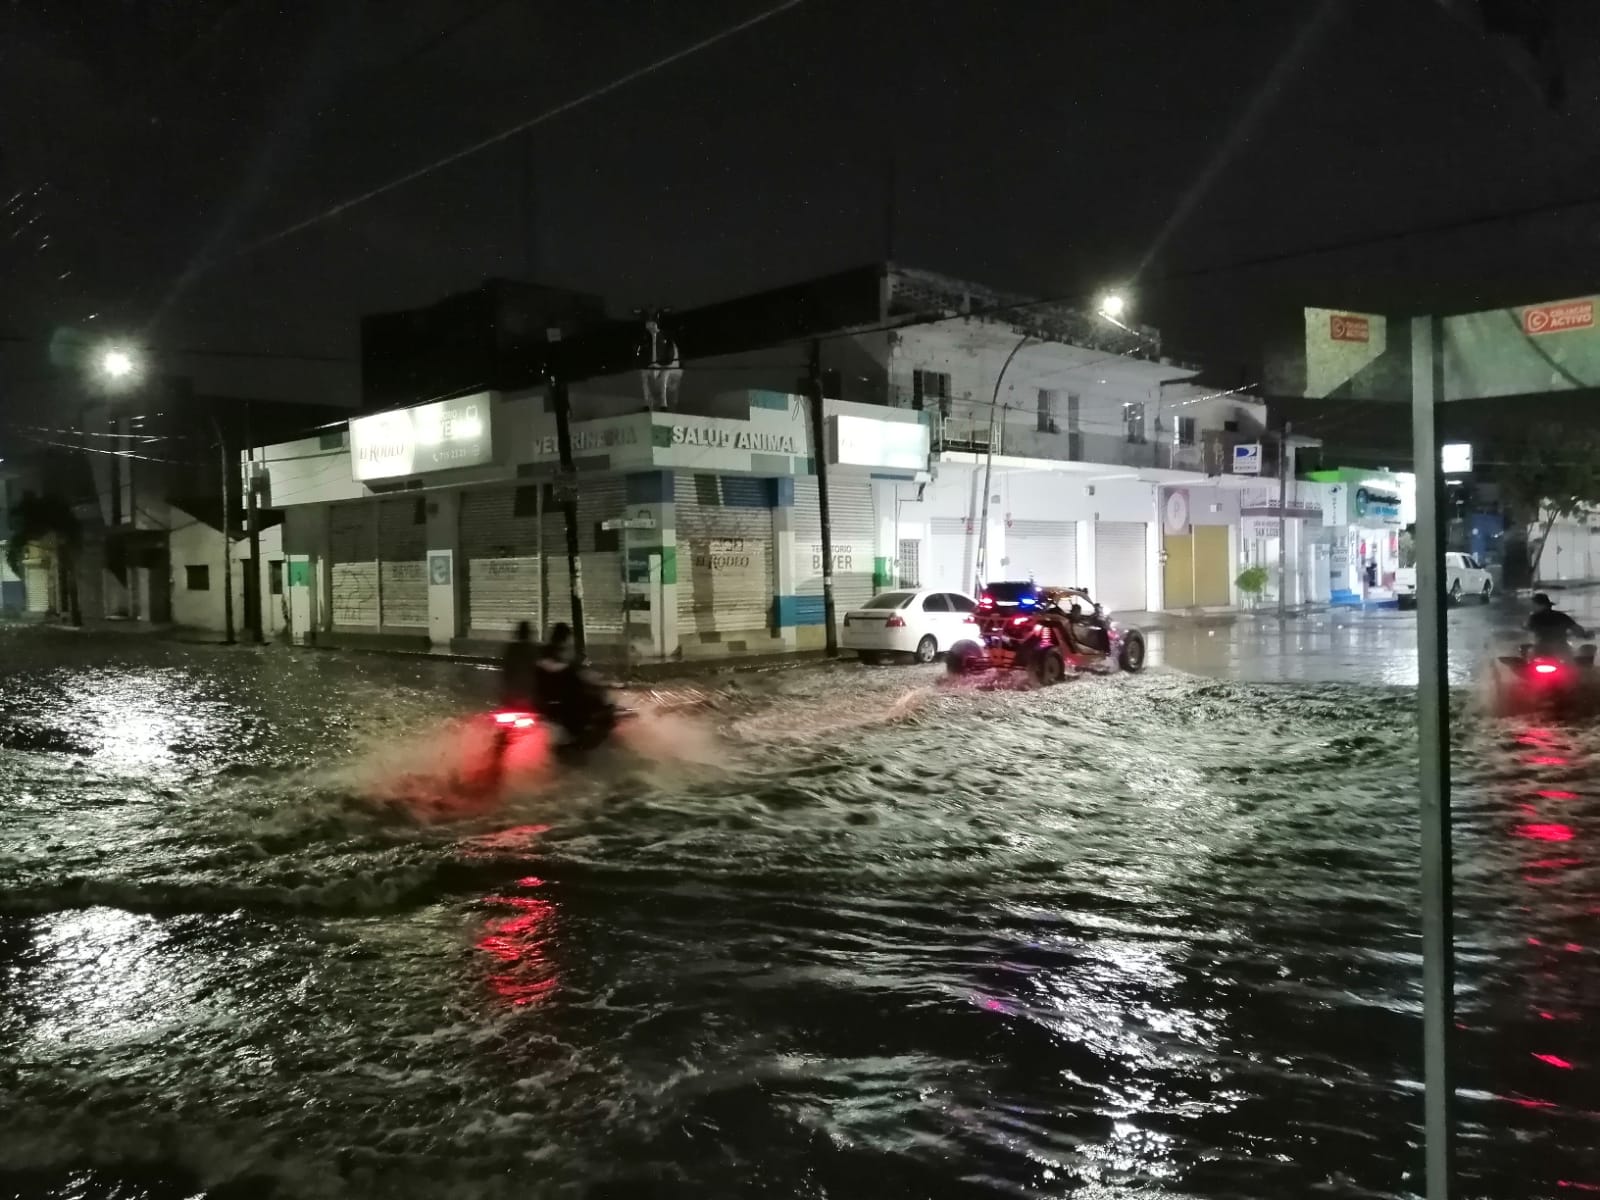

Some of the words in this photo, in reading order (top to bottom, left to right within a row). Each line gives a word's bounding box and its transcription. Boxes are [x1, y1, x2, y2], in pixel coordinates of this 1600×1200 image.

[1550, 313, 1592, 328] ACTIVO
[534, 426, 637, 455] VETRINARIA
[672, 425, 731, 447] SALUD
[737, 431, 801, 454] ANIMAL
[812, 555, 852, 569] BYER
